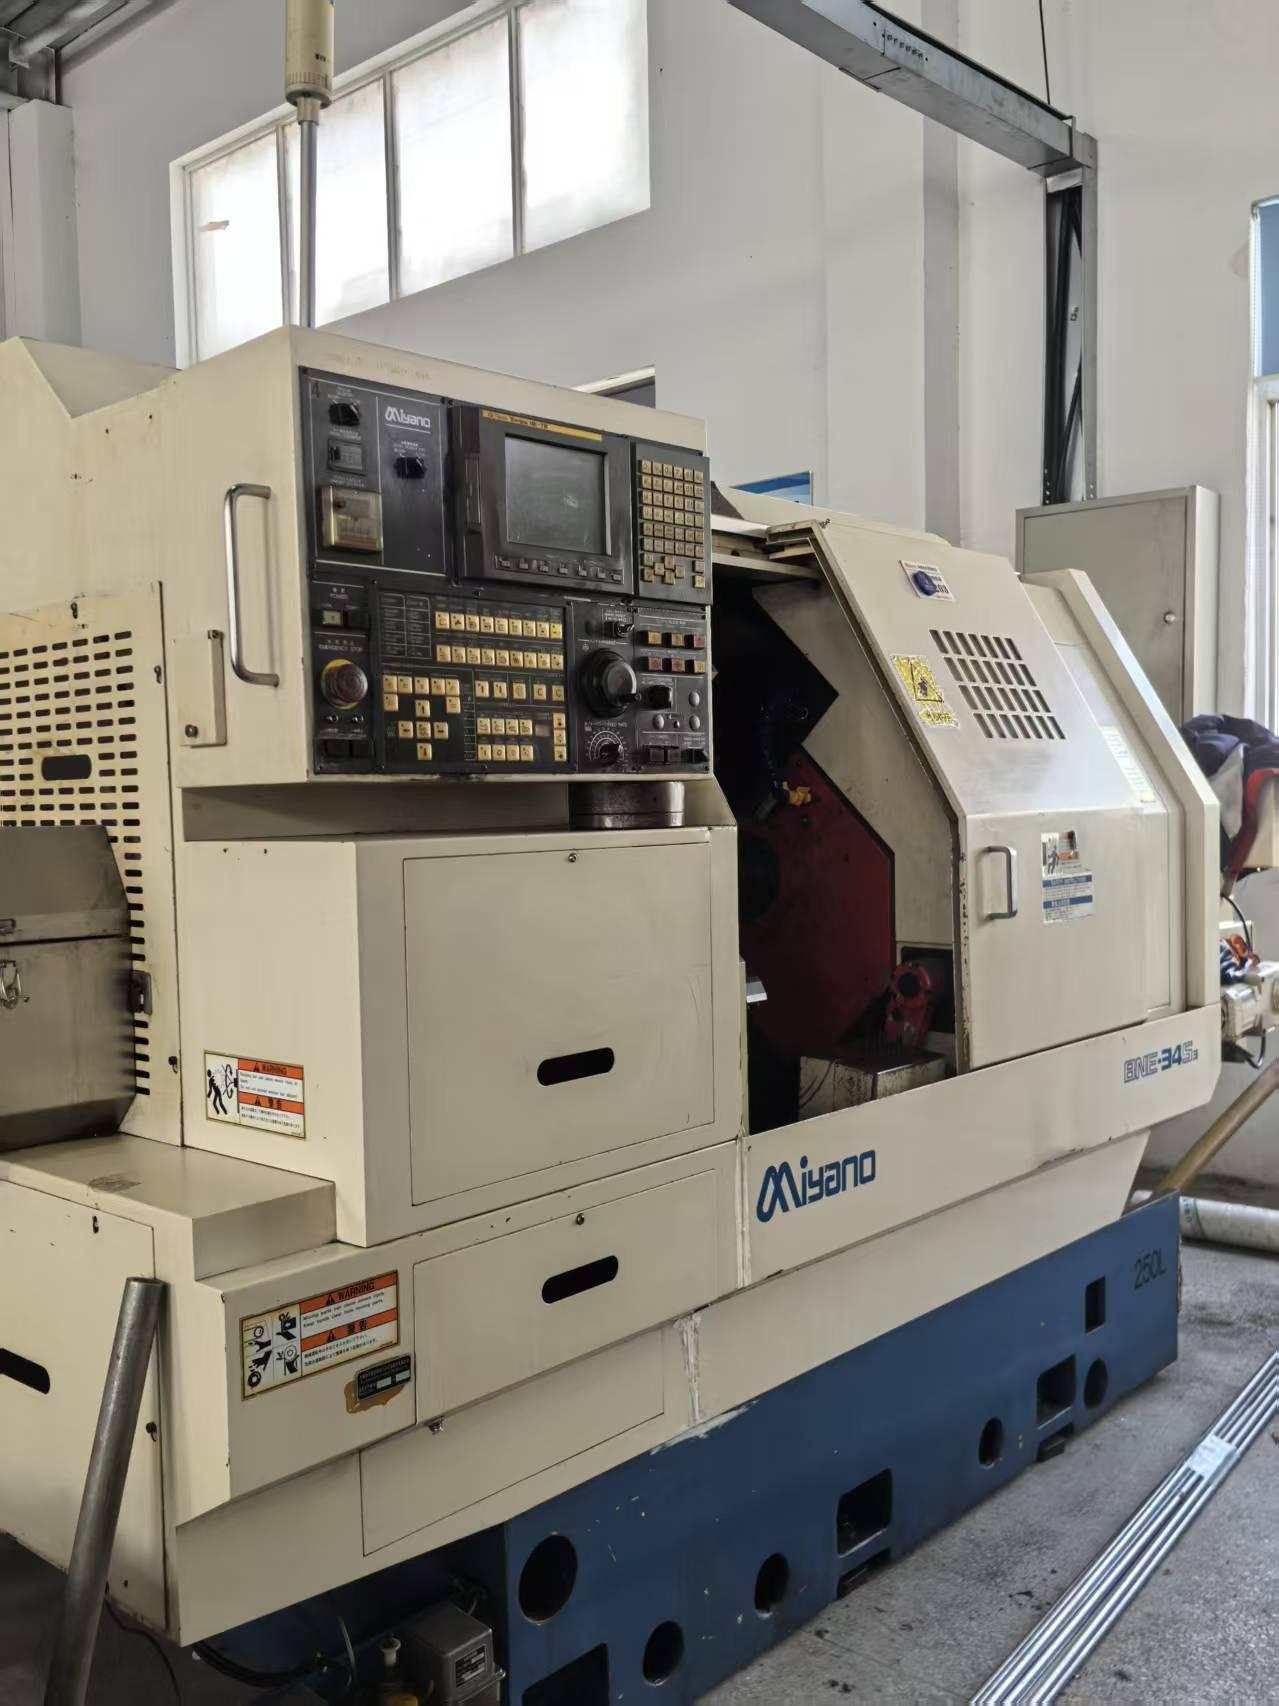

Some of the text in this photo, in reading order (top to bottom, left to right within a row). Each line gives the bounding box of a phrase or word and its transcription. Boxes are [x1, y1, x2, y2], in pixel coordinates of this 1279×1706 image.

[385, 406, 431, 428] Miyano
[756, 1149, 876, 1223] Miyano
[338, 1280, 374, 1300] WARNING
